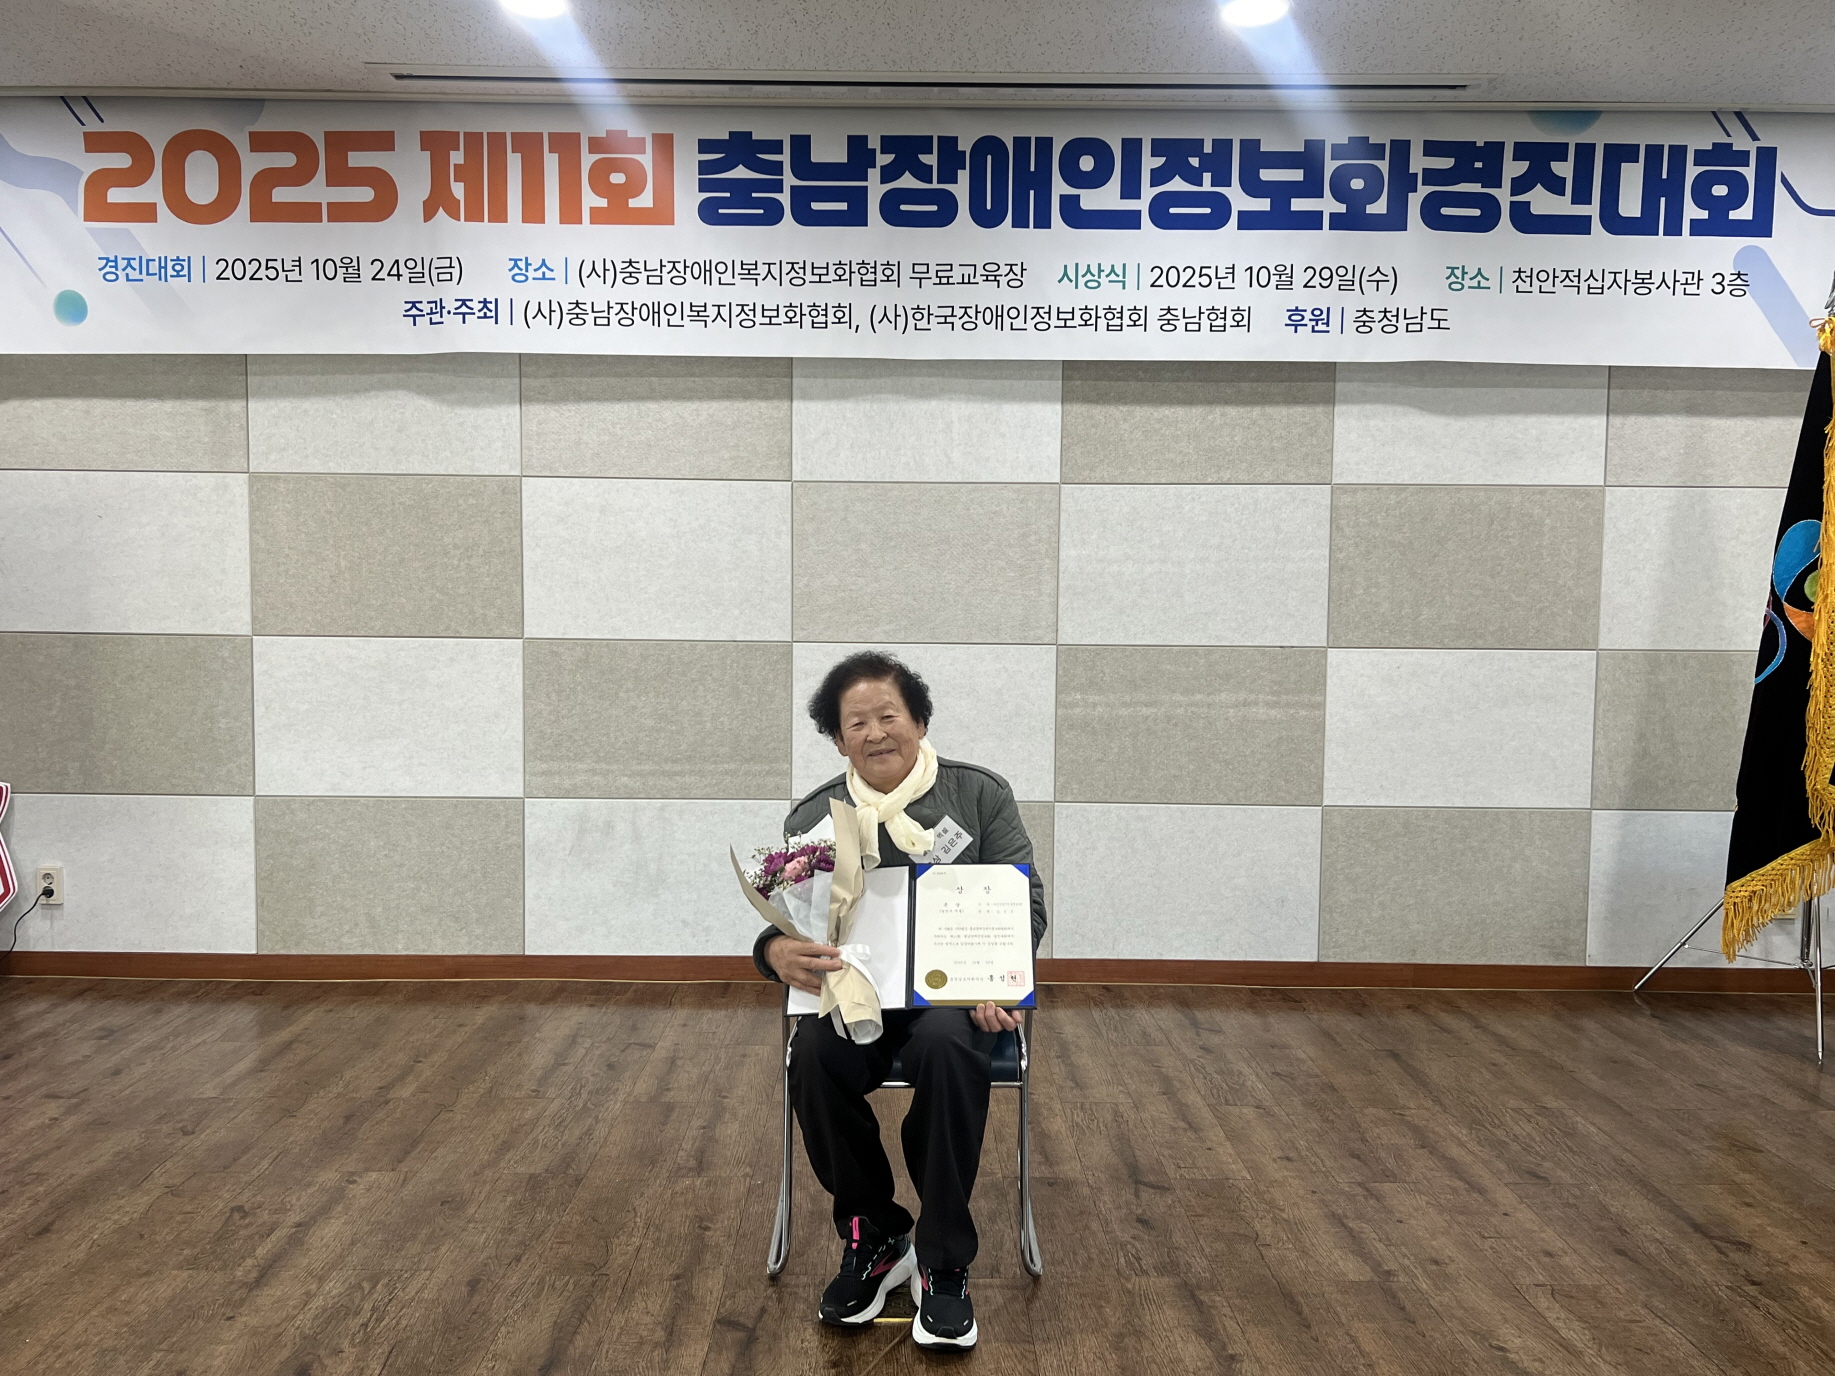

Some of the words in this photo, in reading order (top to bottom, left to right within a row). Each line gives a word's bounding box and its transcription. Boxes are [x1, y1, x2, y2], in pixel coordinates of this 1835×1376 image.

[82, 129, 399, 226] 2025
[419, 129, 675, 226] 제11회
[696, 130, 1778, 239] 충남장애인정보화경진대회
[97, 255, 193, 283] 경진대회
[214, 256, 304, 283] 2025년
[310, 255, 363, 284] 10월
[370, 255, 464, 287] 24일(금)
[507, 256, 557, 284] 장소
[577, 256, 903, 290] (사)충남장애인복지정보화협회
[908, 261, 1028, 290] 무료교육장
[1057, 261, 1128, 291] 시상식
[1149, 262, 1237, 291] 2025년
[1244, 262, 1295, 292] 10월
[1302, 263, 1399, 296] 29일(수)
[1444, 264, 1492, 293] 장소
[1510, 266, 1705, 297] 천안적십자봉사관
[1710, 271, 1751, 298] 3층
[402, 297, 500, 327] 주관·주최
[522, 298, 861, 334] (사)충남장애인복지정보화협회,
[869, 303, 1149, 336] (사)한국장애인정보화협회
[1156, 305, 1253, 334] 충남협회
[1283, 305, 1332, 335] 후원
[1351, 305, 1452, 335] 충청남도
[941, 830, 963, 855] 김은주
